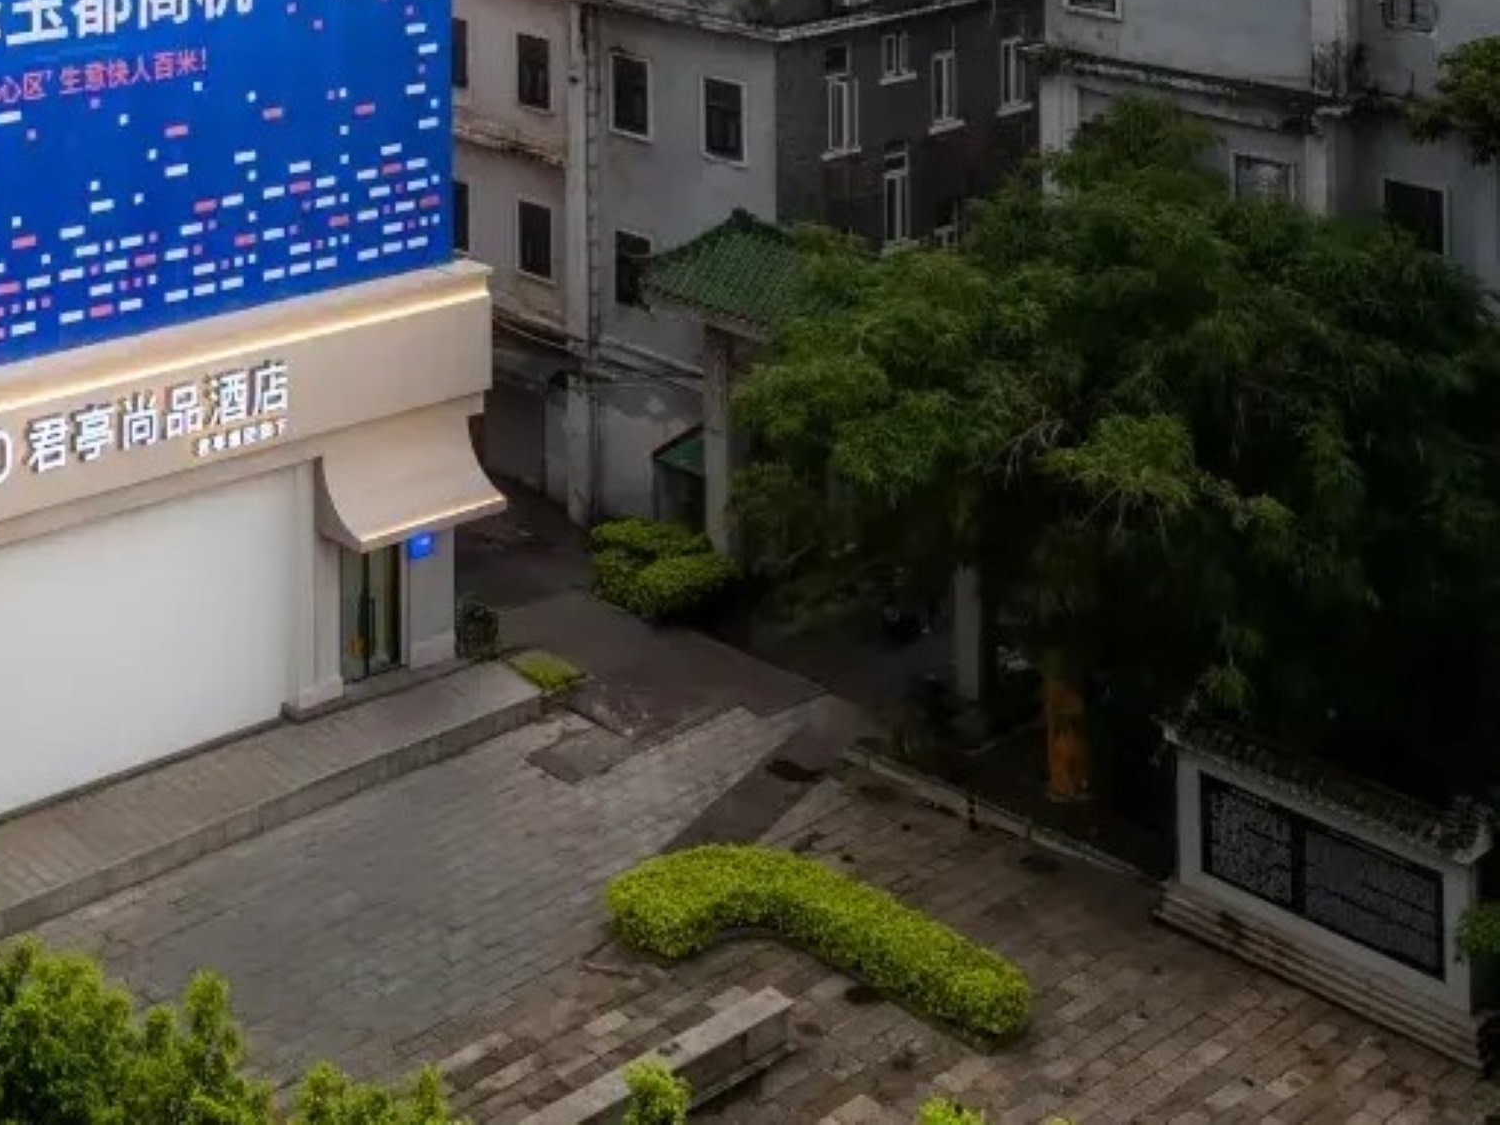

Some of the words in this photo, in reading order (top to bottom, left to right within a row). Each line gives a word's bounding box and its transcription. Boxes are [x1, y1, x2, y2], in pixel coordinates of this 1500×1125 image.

[26, 360, 289, 473] 君亭尚品酒店
